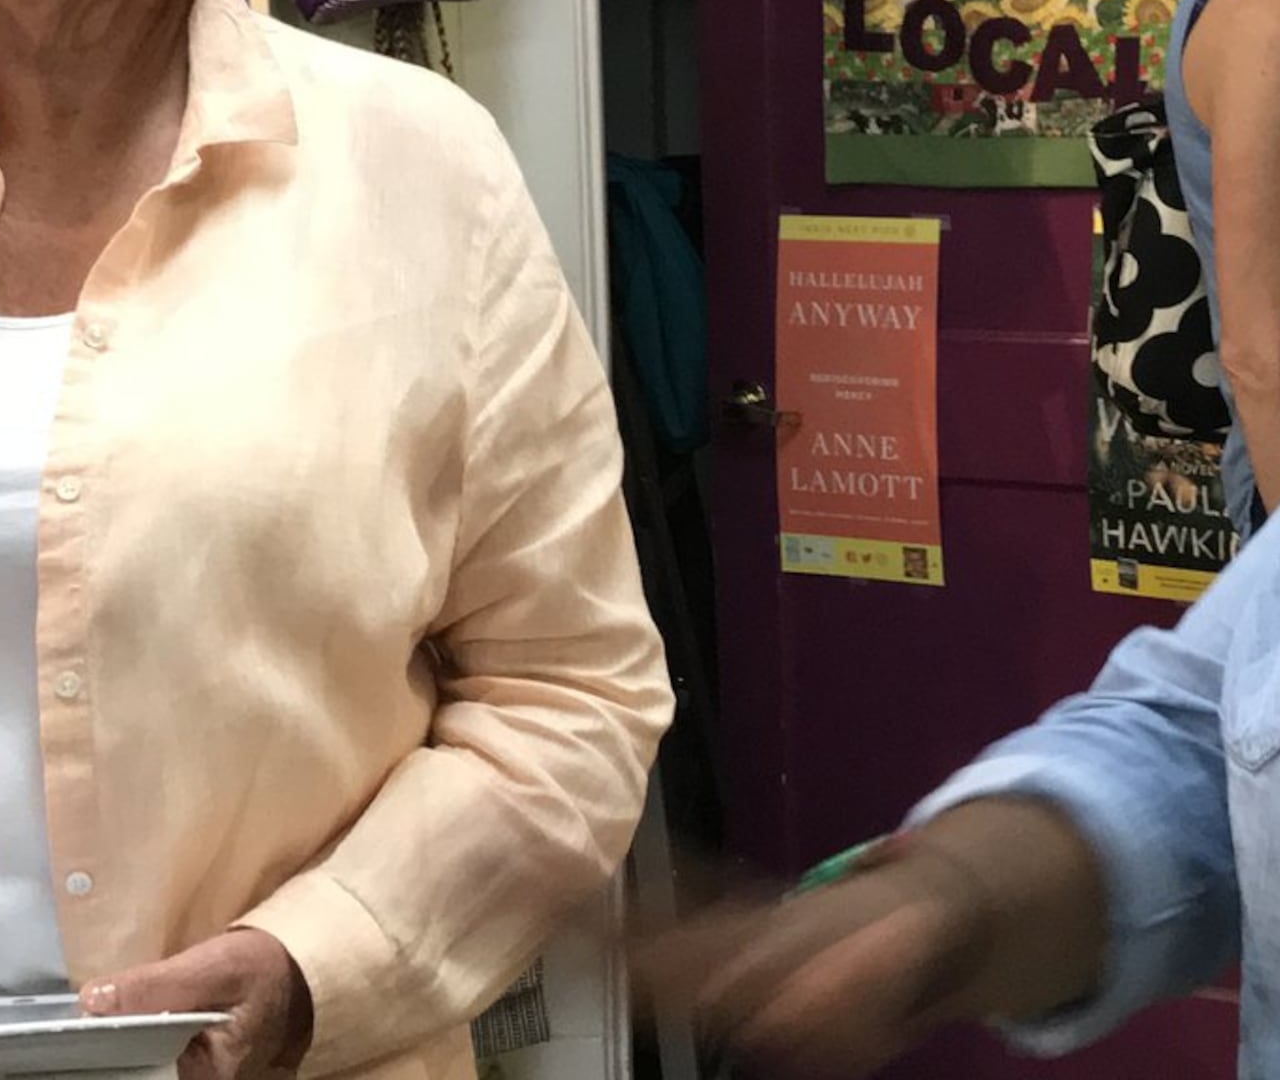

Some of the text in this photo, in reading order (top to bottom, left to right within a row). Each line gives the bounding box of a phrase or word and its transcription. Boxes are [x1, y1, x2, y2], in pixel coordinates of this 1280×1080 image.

[788, 270, 924, 293] HALLELUJAH
[789, 301, 923, 331] ANYWAY
[810, 432, 900, 461] ANNE
[790, 467, 924, 501] LAMOTT
[1126, 478, 1230, 518] PAUL
